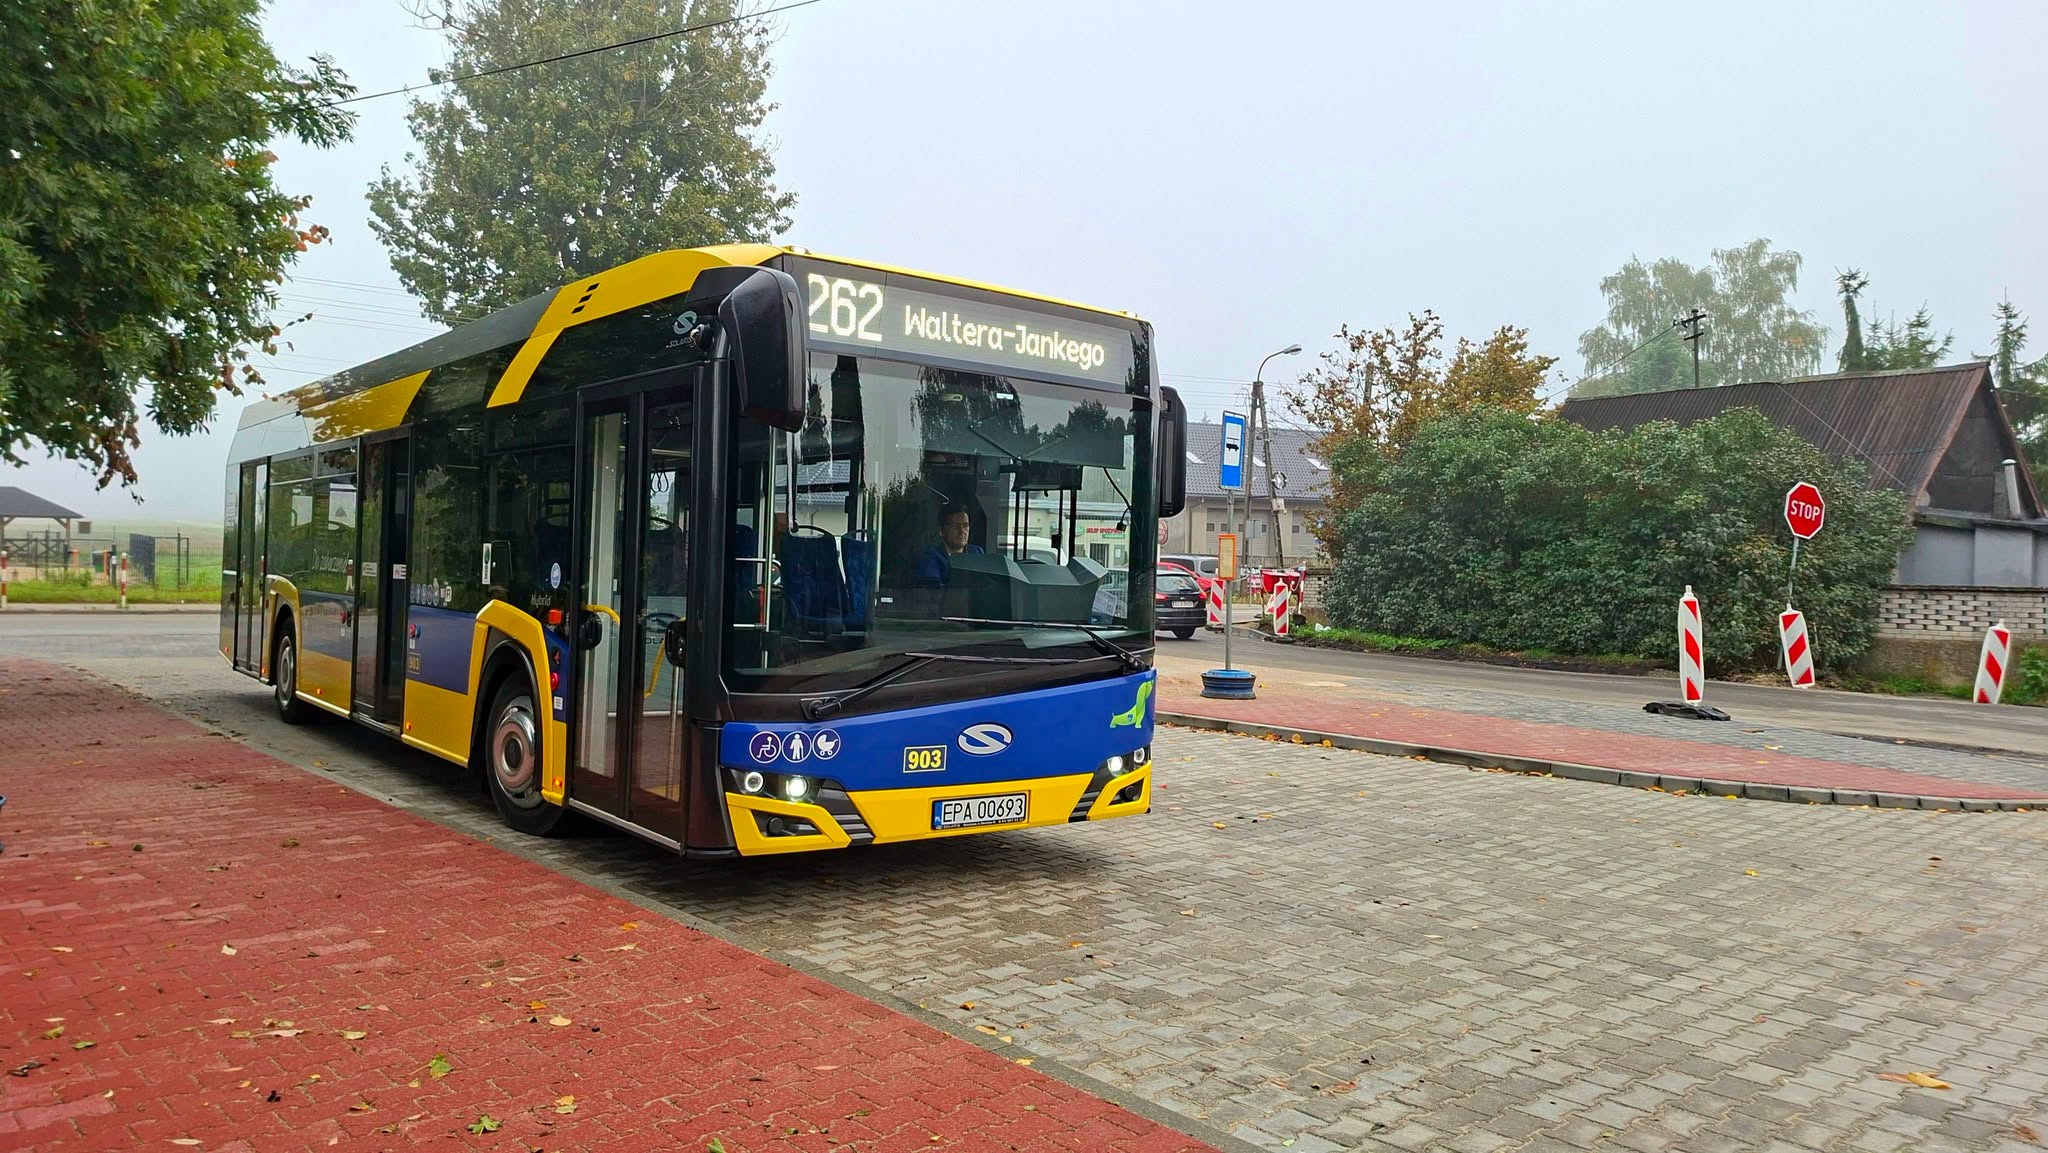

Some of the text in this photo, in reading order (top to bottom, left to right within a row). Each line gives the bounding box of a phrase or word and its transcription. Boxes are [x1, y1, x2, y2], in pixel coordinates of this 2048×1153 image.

[808, 273, 1105, 371] 262 Waltera-Jankego
[1790, 499, 1821, 521] STOP
[530, 592, 552, 609] Hybrid
[908, 749, 942, 770] 903
[943, 798, 1024, 823] EPA 00693
